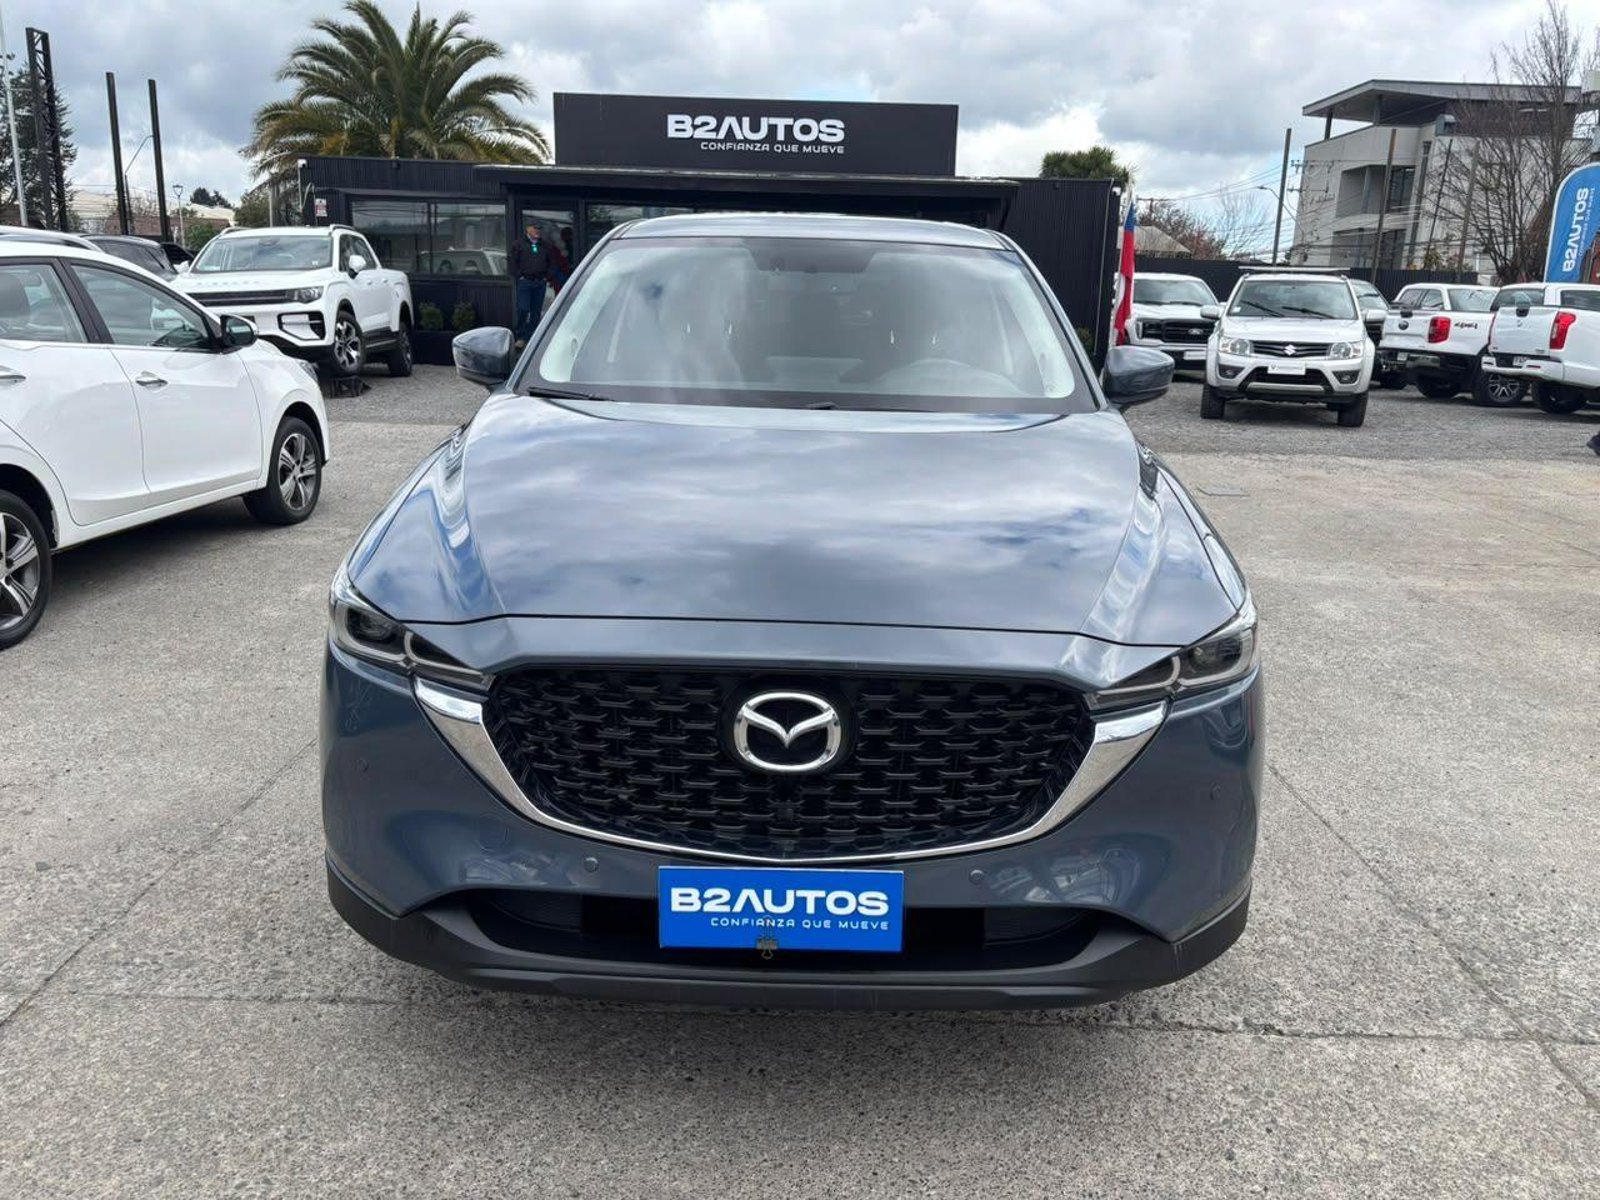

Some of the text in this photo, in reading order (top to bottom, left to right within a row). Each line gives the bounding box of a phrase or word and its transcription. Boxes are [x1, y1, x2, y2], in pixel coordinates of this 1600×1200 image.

[667, 114, 845, 142] B2AUTOS
[700, 141, 845, 154] CONFIANZA QUE MUEVE
[1562, 187, 1589, 272] B2AUTOS
[671, 887, 889, 916] B2AUTOS
[710, 917, 889, 930] CONFIANZA QUE MUEVE
